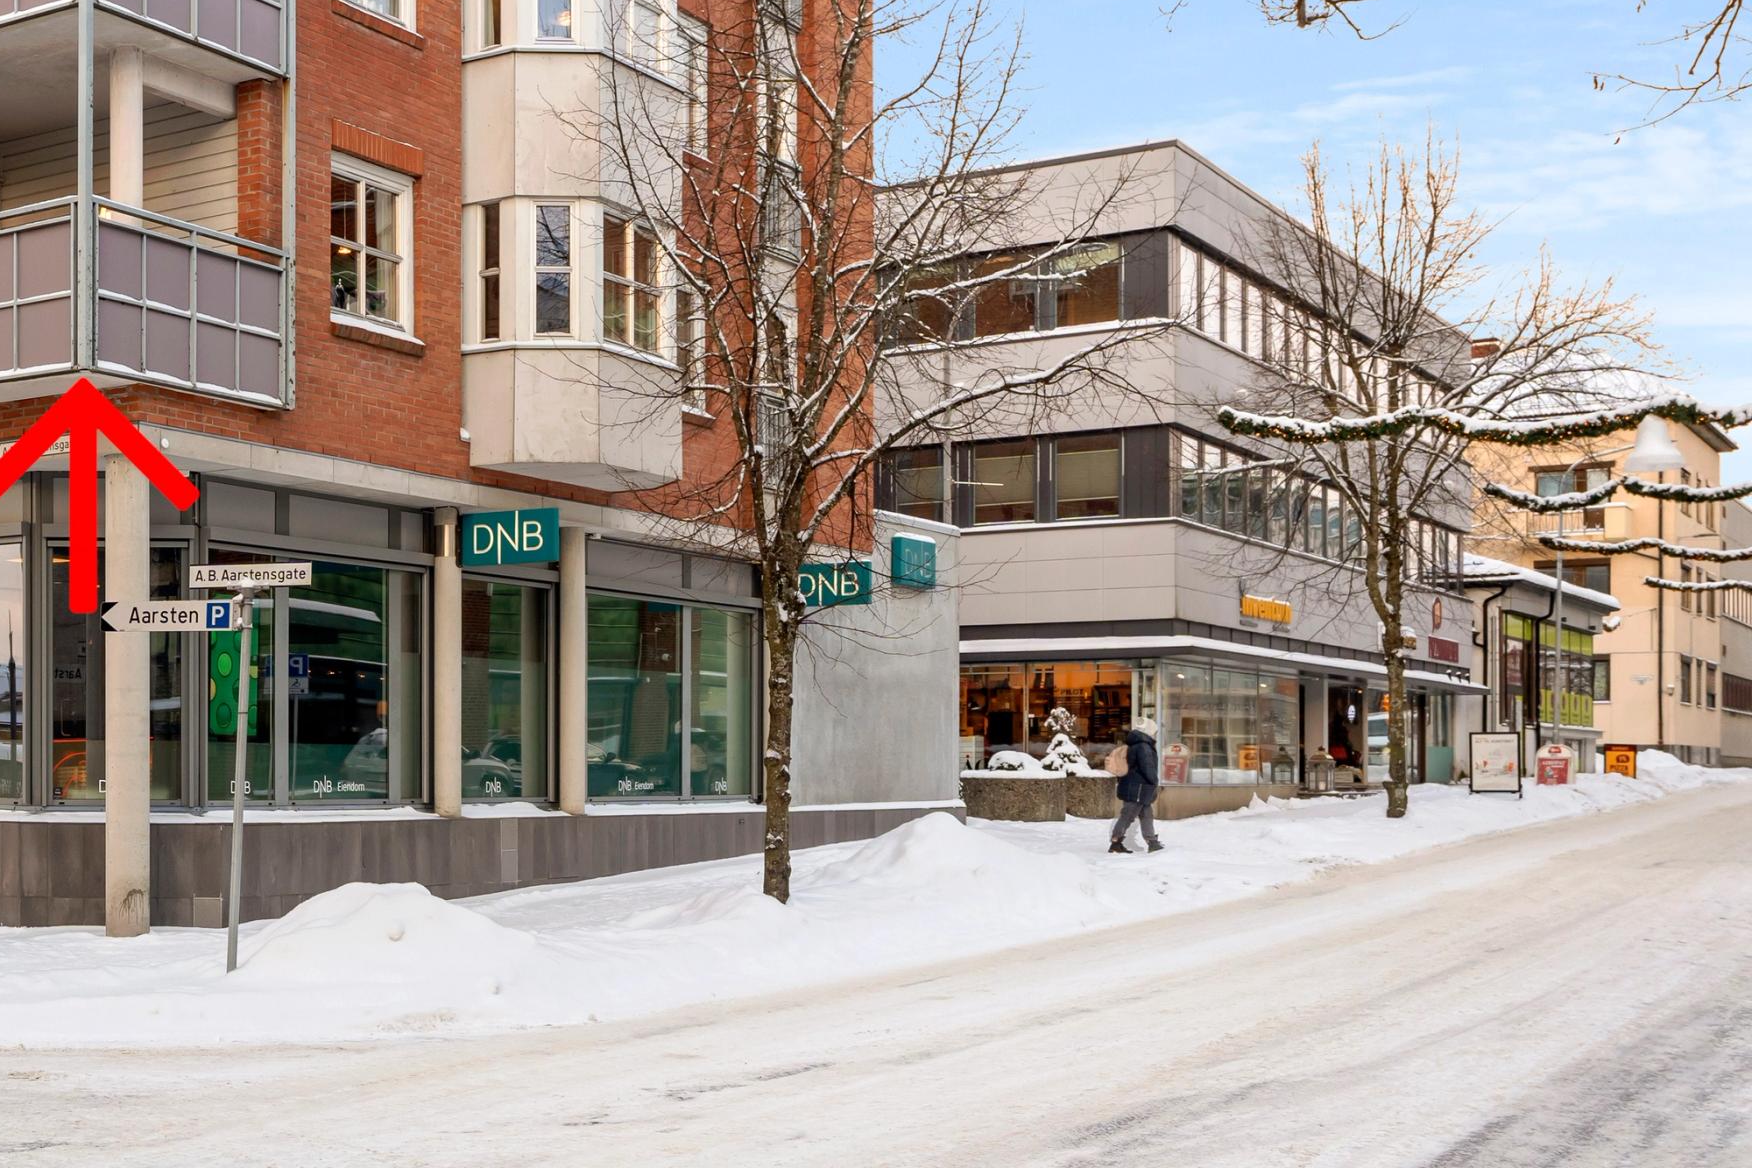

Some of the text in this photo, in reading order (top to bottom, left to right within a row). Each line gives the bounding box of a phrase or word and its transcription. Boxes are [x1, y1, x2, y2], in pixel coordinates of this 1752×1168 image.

[473, 510, 544, 565] DNB
[221, 567, 307, 583] Aarstensgate
[798, 563, 859, 607] DNB
[129, 606, 225, 626] Aarsten P
[313, 775, 365, 799] DNB Eiendom
[485, 777, 502, 797] DNB
[618, 776, 632, 796] DNB
[715, 777, 728, 795] DNB
